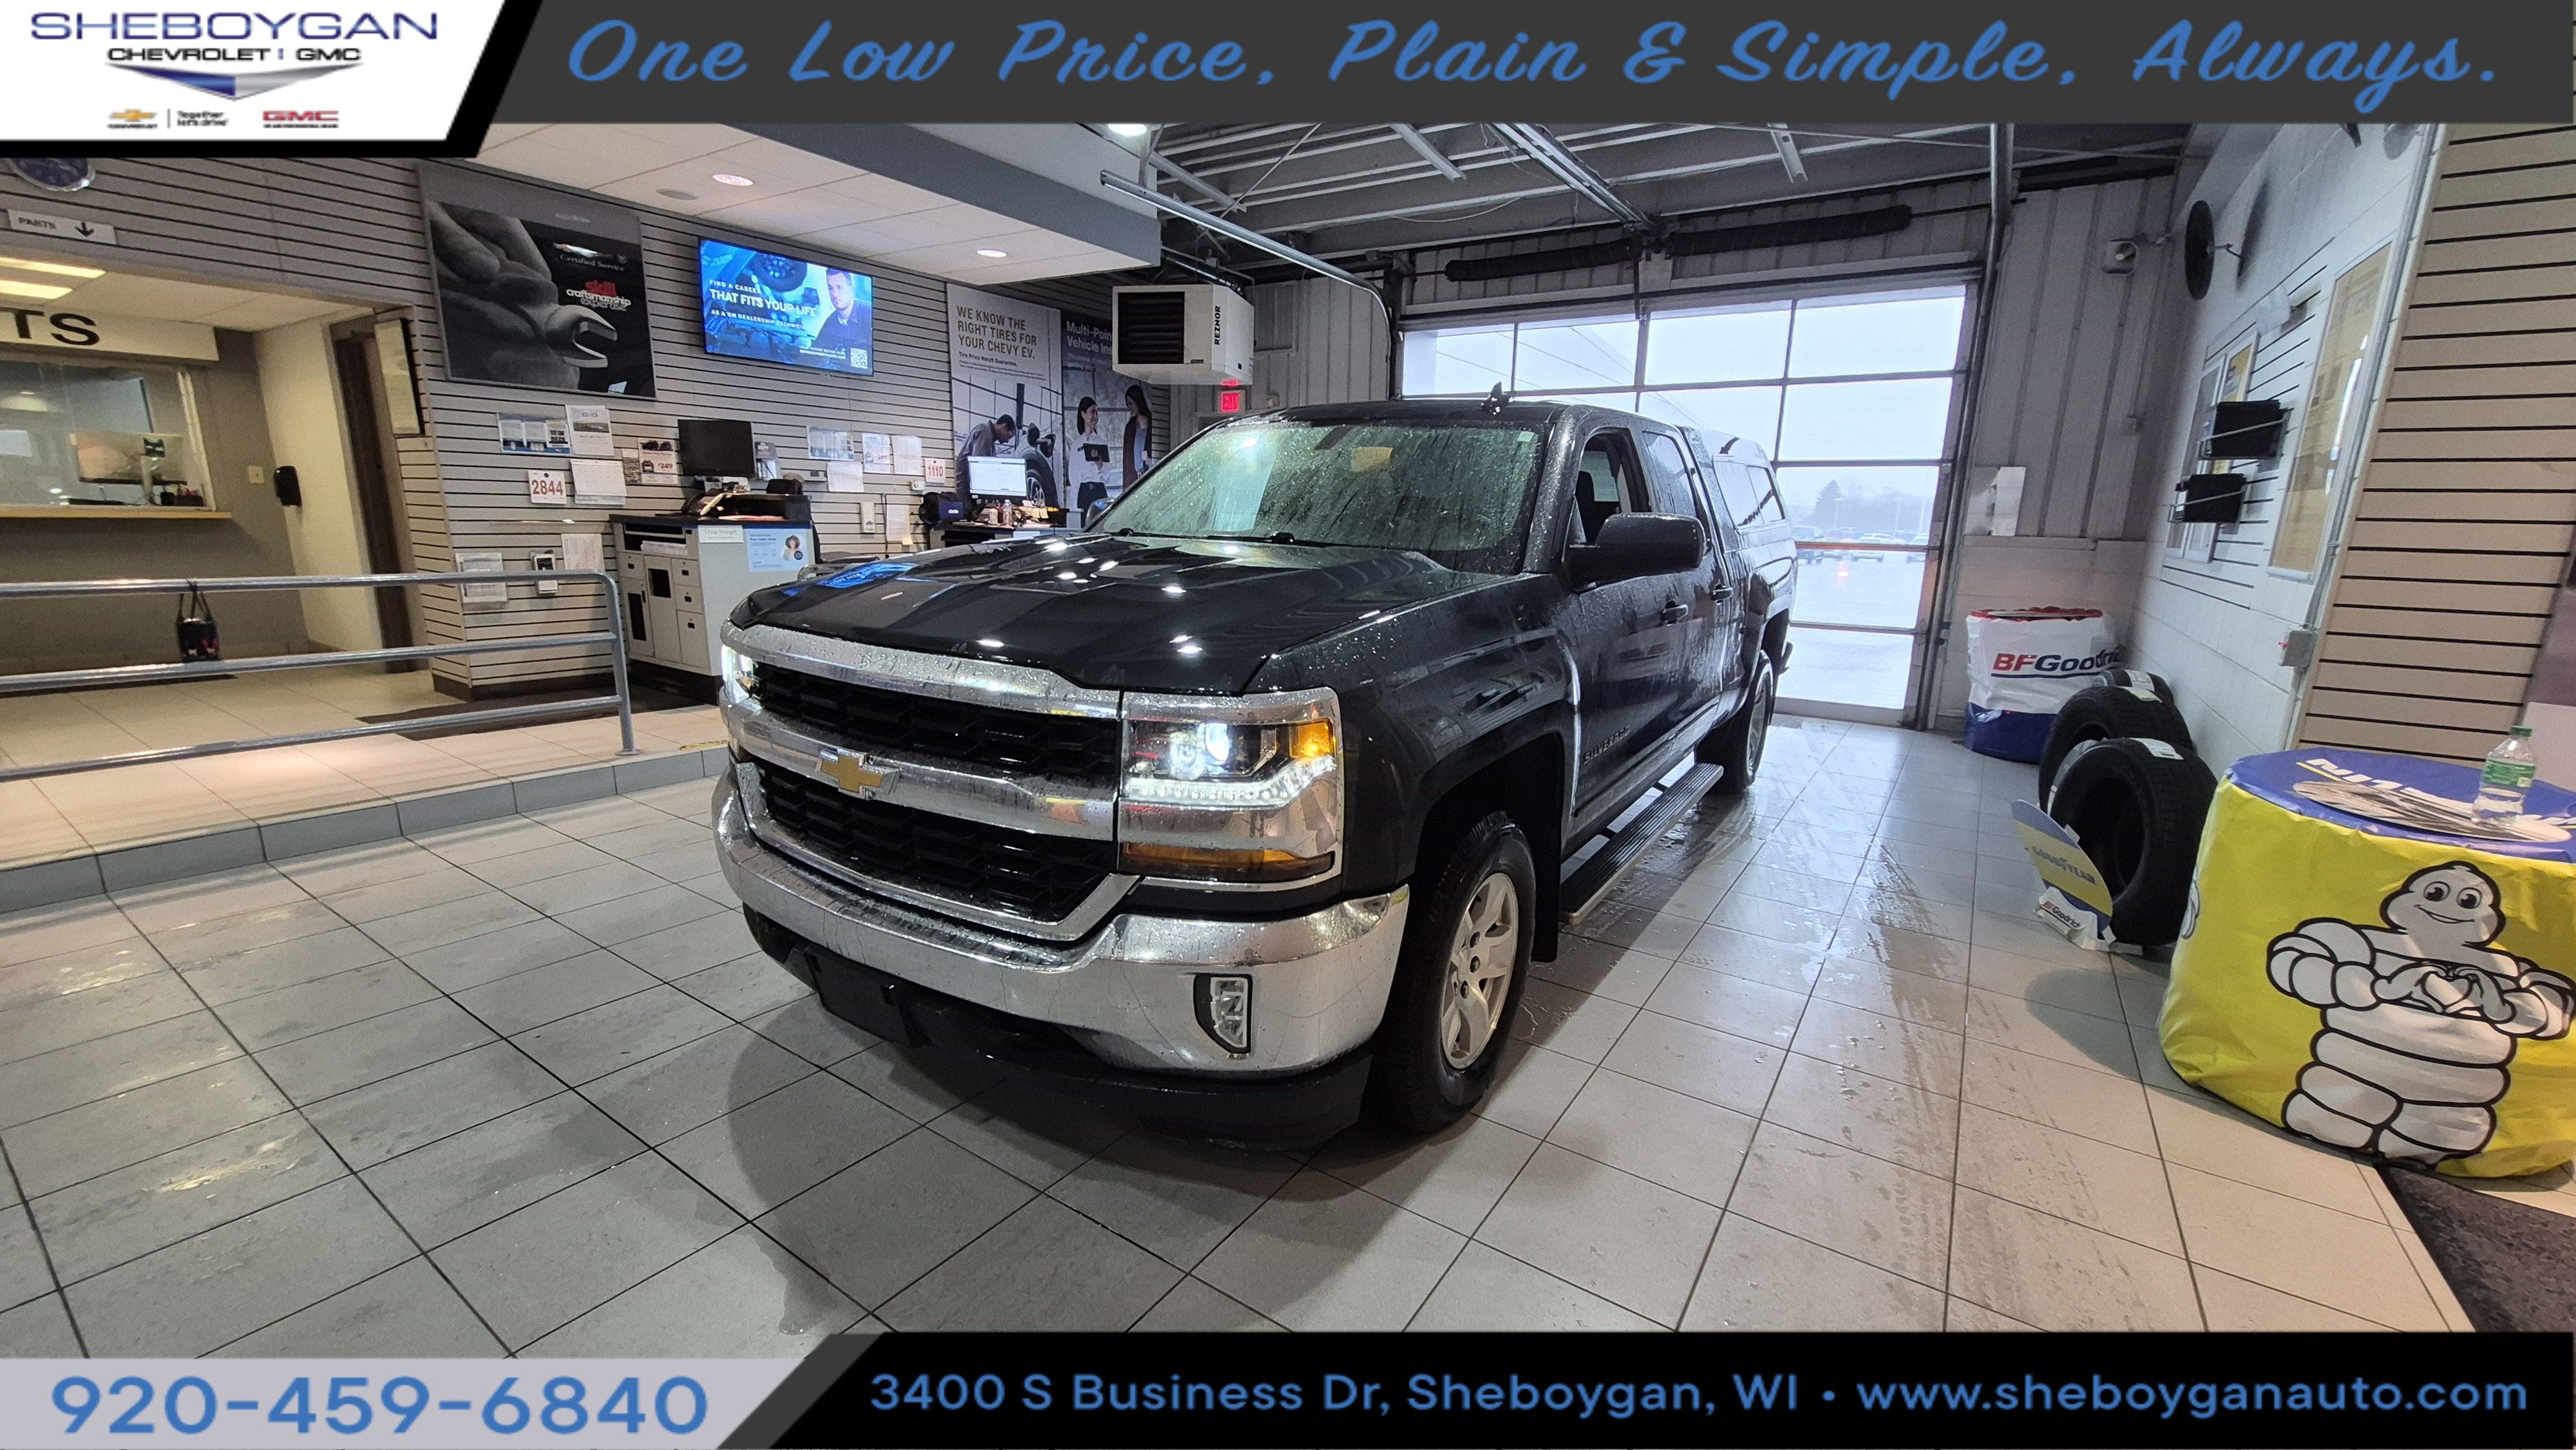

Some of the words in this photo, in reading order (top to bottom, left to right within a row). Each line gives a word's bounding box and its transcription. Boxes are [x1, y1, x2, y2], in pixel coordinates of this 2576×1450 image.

[17, 216, 57, 229] PARTS
[710, 279, 726, 288] FIND
[566, 288, 632, 306] craftsmanship
[710, 288, 739, 304] THAT
[741, 294, 764, 308] FITS
[764, 299, 795, 312] YOUR
[795, 305, 817, 317] LIFE
[957, 306, 973, 319] WE
[976, 310, 1005, 326] KNOW
[1008, 317, 1026, 330] THE
[958, 321, 987, 335] RIGHT
[990, 326, 1017, 343] TIRES
[1019, 333, 1037, 346] FOR
[1066, 321, 1112, 341] Multi-Poin
[958, 334, 985, 350] YOUR
[988, 340, 1019, 356] CHEVY
[1021, 346, 1036, 359] EV.
[1066, 335, 1099, 353] Vehicle
[928, 465, 943, 478] 1110
[531, 479, 564, 496] 2844
[1993, 645, 2125, 672] BFGoodri
[1583, 726, 1630, 765] SILVERADO
[2043, 901, 2081, 928] BFGoodrich
